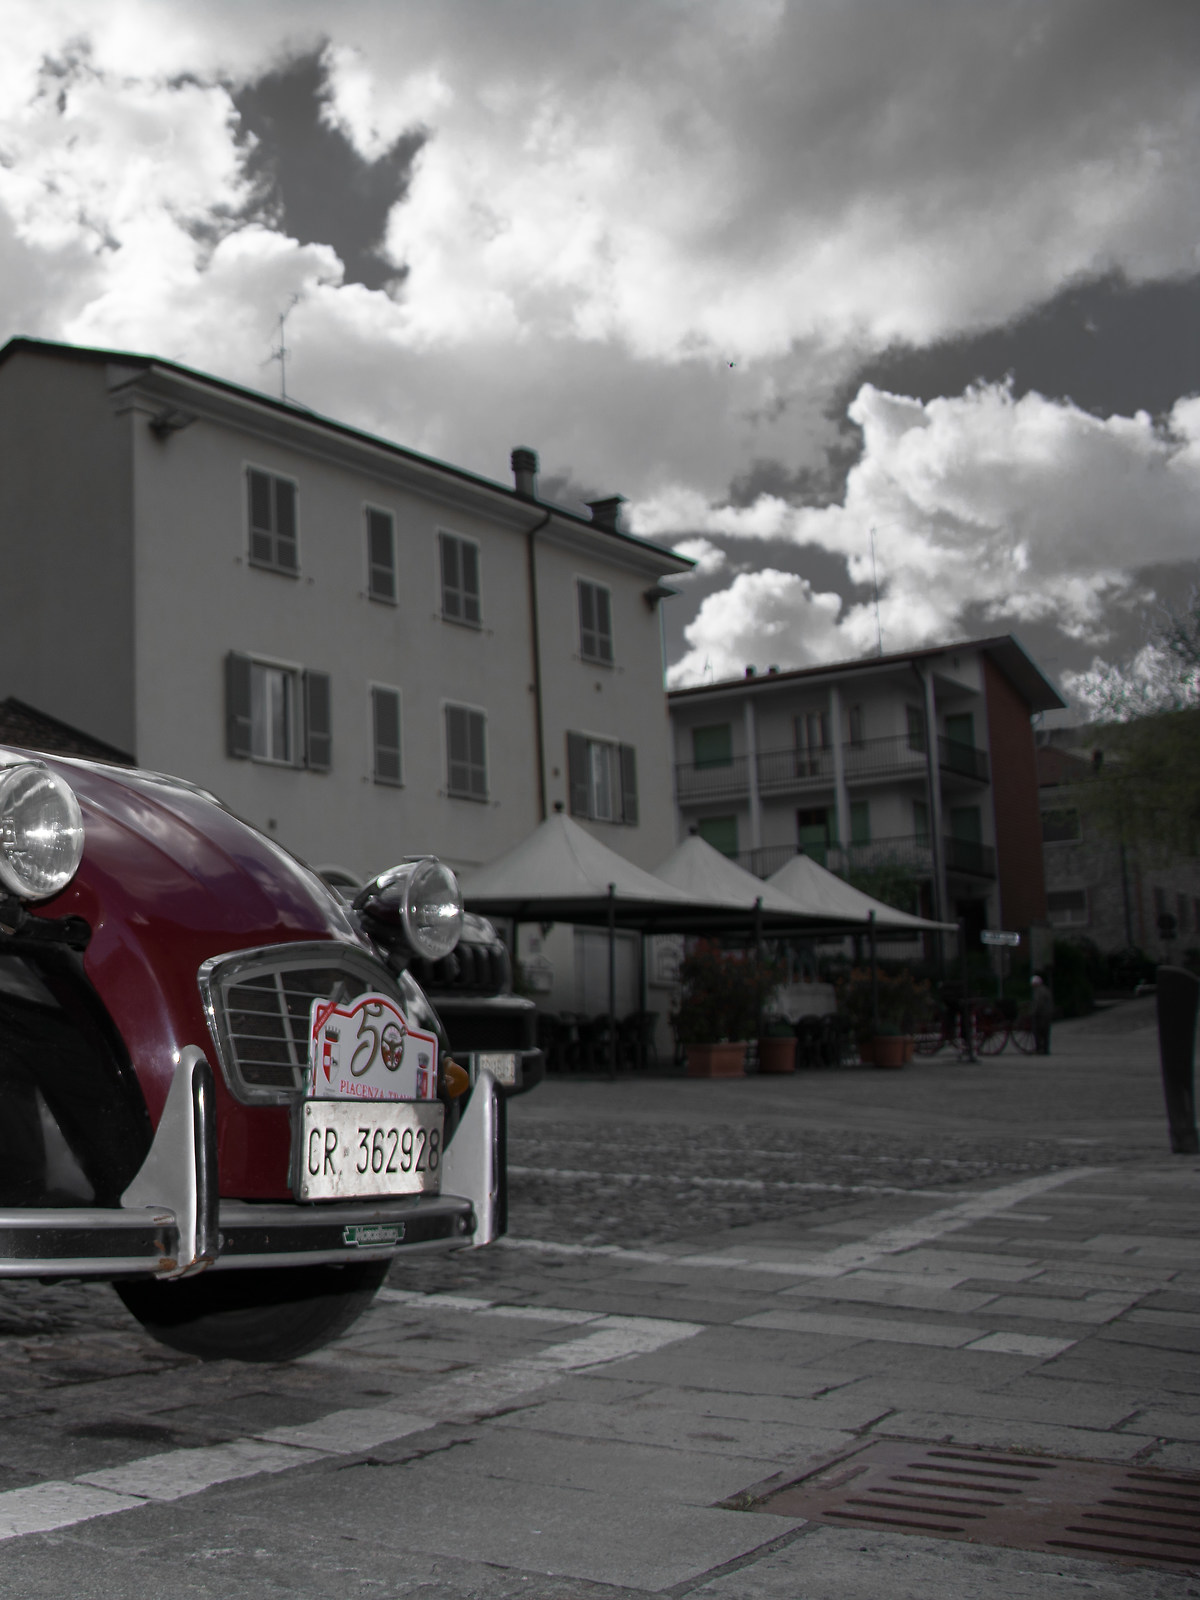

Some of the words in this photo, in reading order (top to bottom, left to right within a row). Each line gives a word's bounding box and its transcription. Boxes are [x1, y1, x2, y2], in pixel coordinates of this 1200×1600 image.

[340, 1079, 384, 1099] PIACENZA
[308, 1127, 337, 1176] CR
[356, 1127, 440, 1174] 362928
